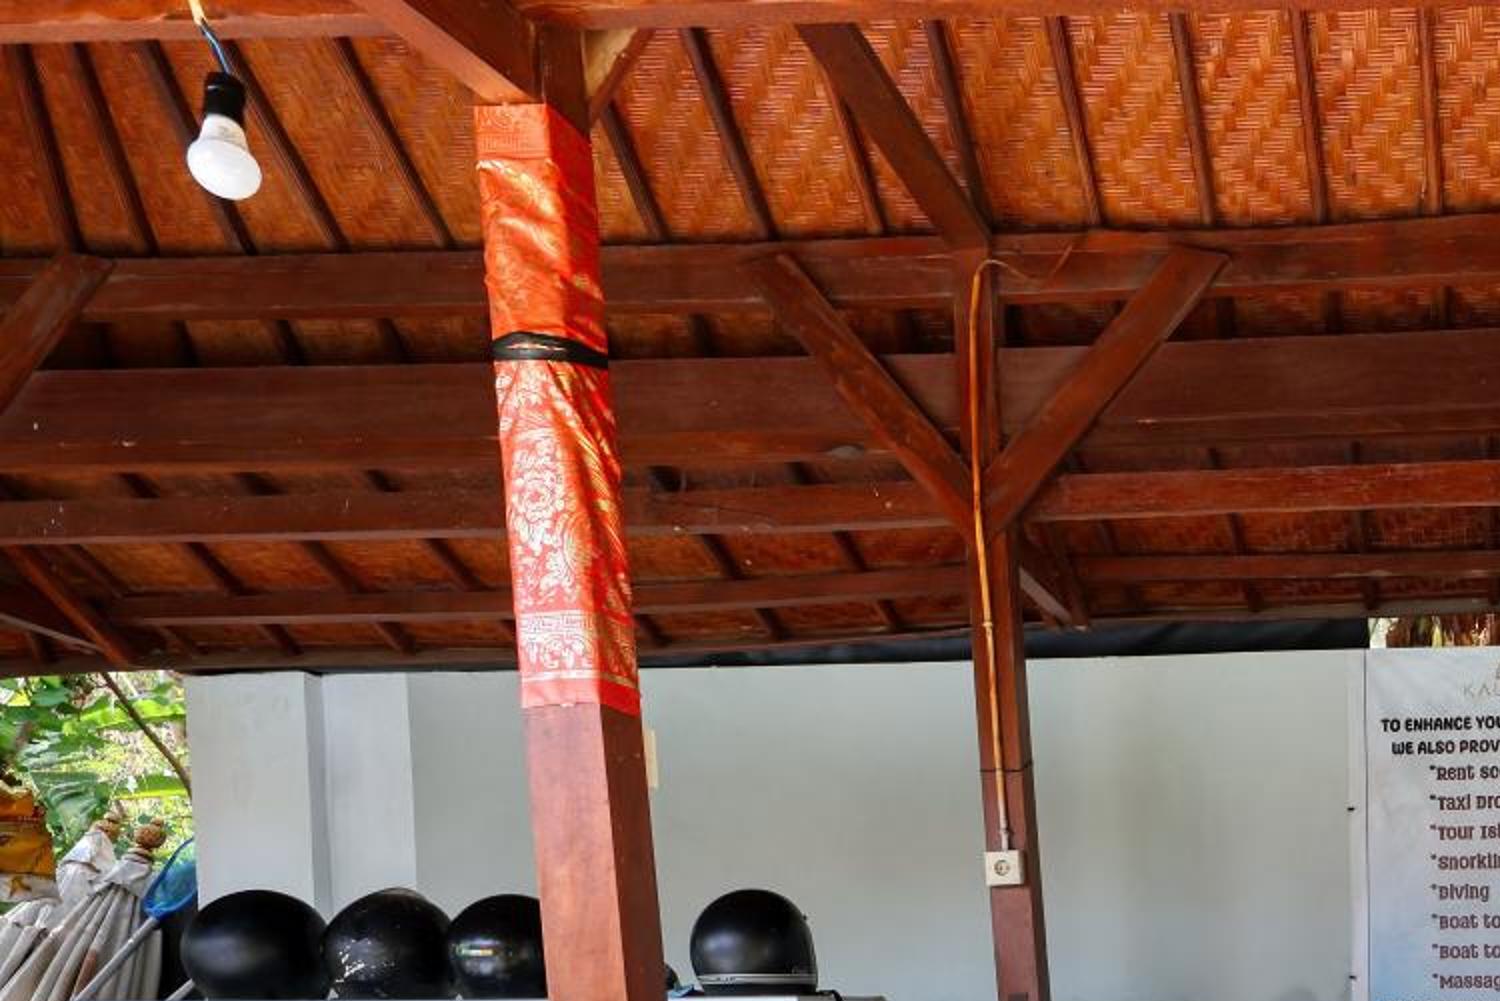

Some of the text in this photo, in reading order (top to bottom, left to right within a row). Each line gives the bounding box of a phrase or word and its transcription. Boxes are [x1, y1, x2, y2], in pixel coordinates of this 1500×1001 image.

[1381, 717, 1401, 732] TO
[1405, 716, 1473, 732] ENHANCE
[1392, 741, 1414, 755] WE
[1418, 740, 1455, 755] ALSO
